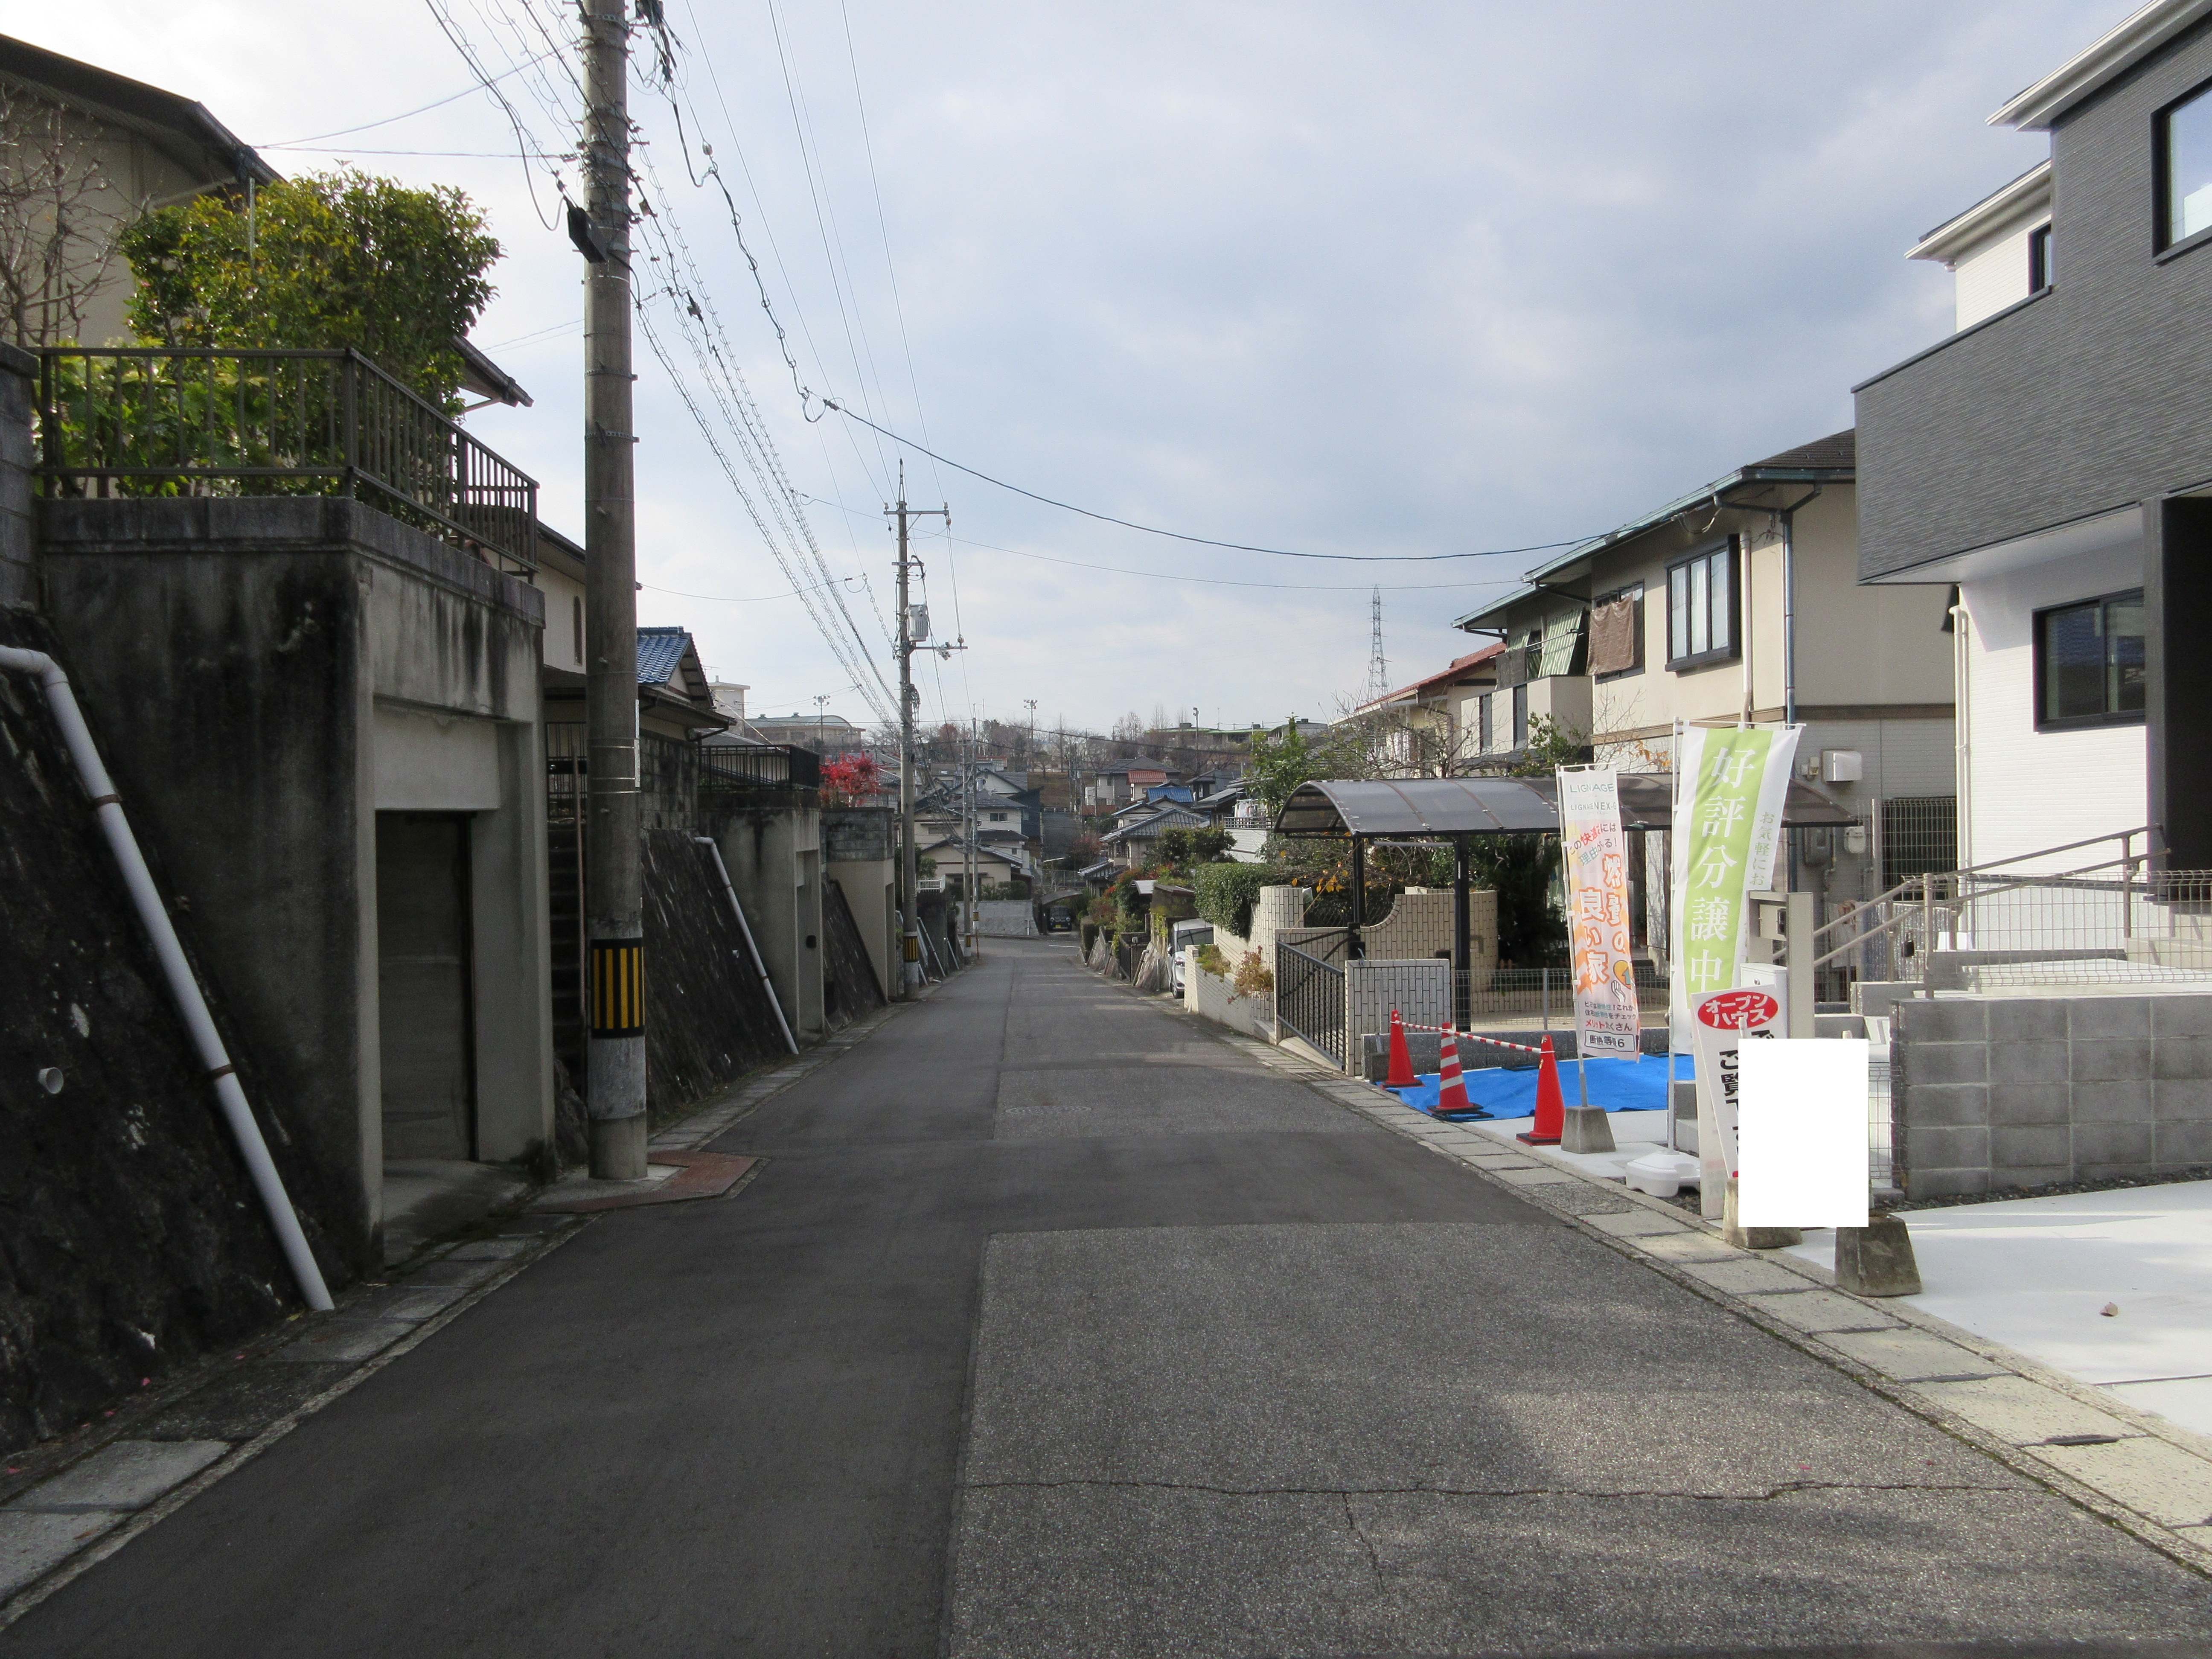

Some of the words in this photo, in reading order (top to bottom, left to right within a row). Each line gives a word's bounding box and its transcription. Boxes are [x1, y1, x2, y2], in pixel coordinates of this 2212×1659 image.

[1570, 783, 1614, 793] LIGNAGE
[1691, 747, 1755, 992] 好評分譲中
[1579, 887, 1610, 984] 良い家
[1705, 995, 1768, 1014] オープン
[1712, 1008, 1769, 1027] ハウス
